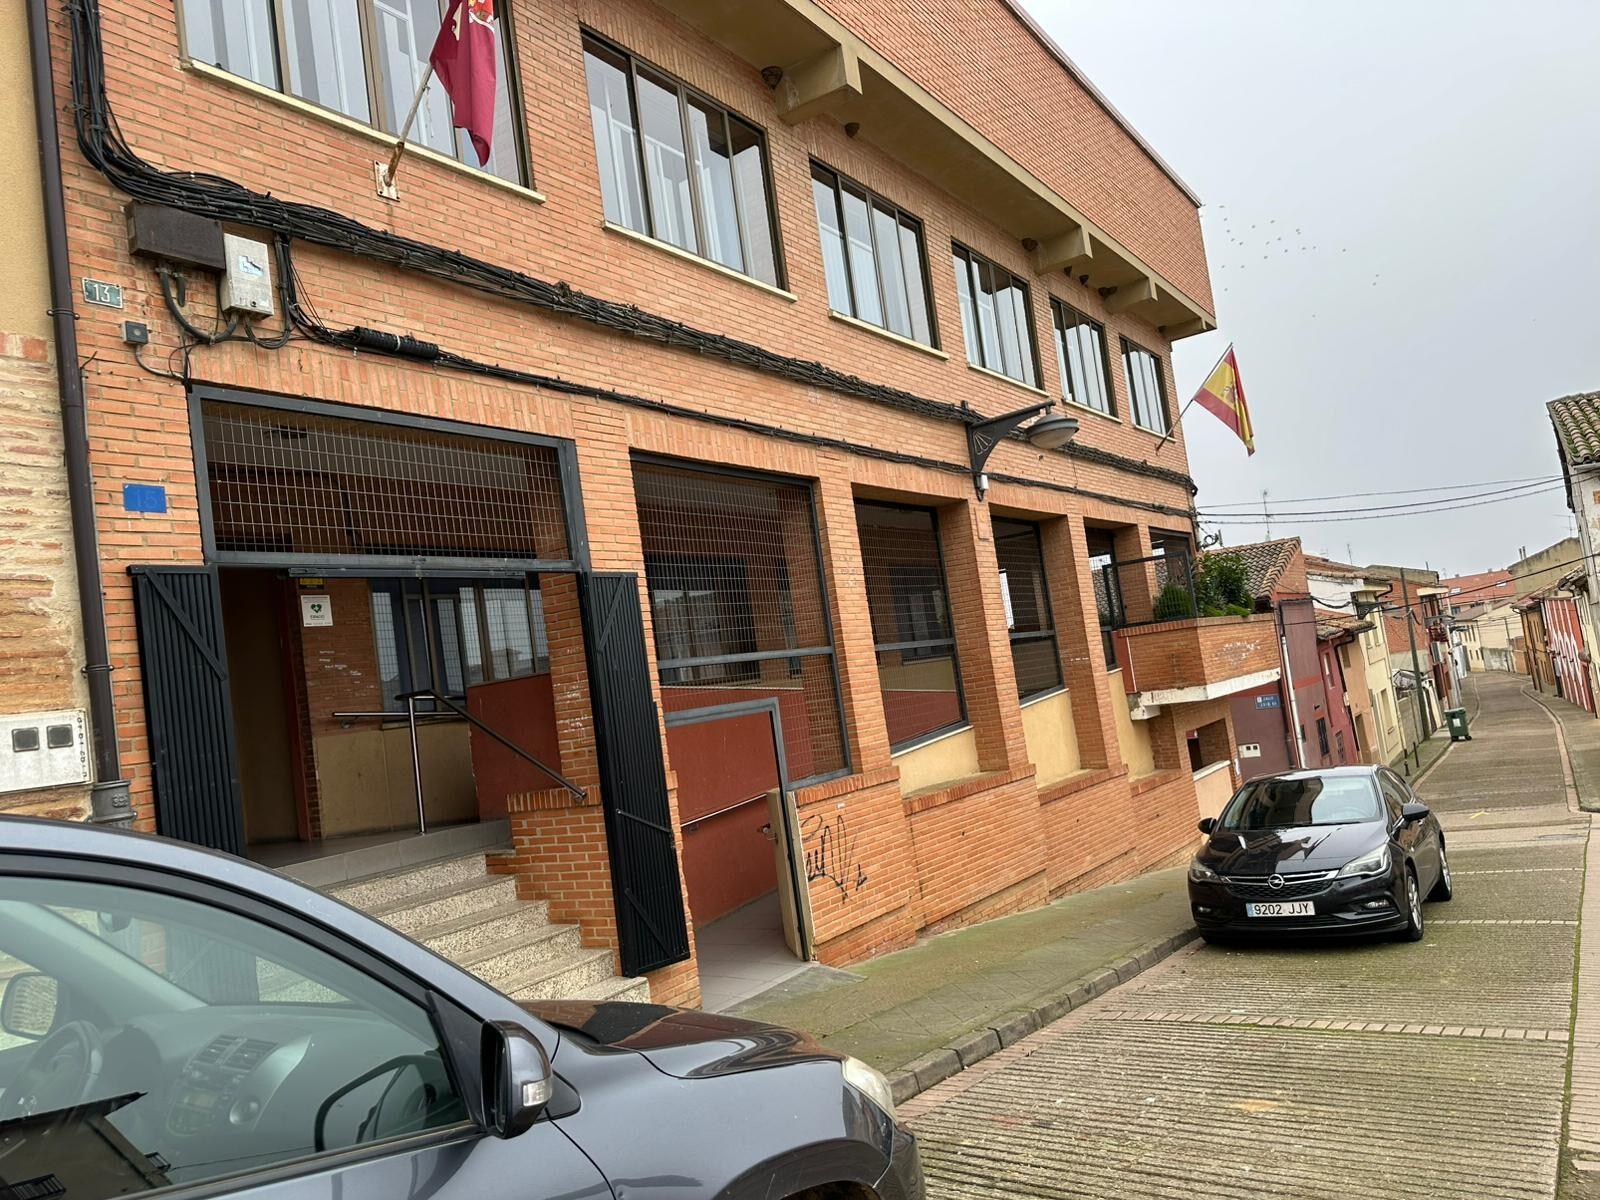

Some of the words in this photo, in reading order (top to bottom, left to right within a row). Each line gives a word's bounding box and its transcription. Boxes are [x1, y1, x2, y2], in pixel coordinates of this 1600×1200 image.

[93, 283, 110, 302] 13
[1254, 903, 1283, 915] 9202
[1288, 902, 1309, 914] JJY
